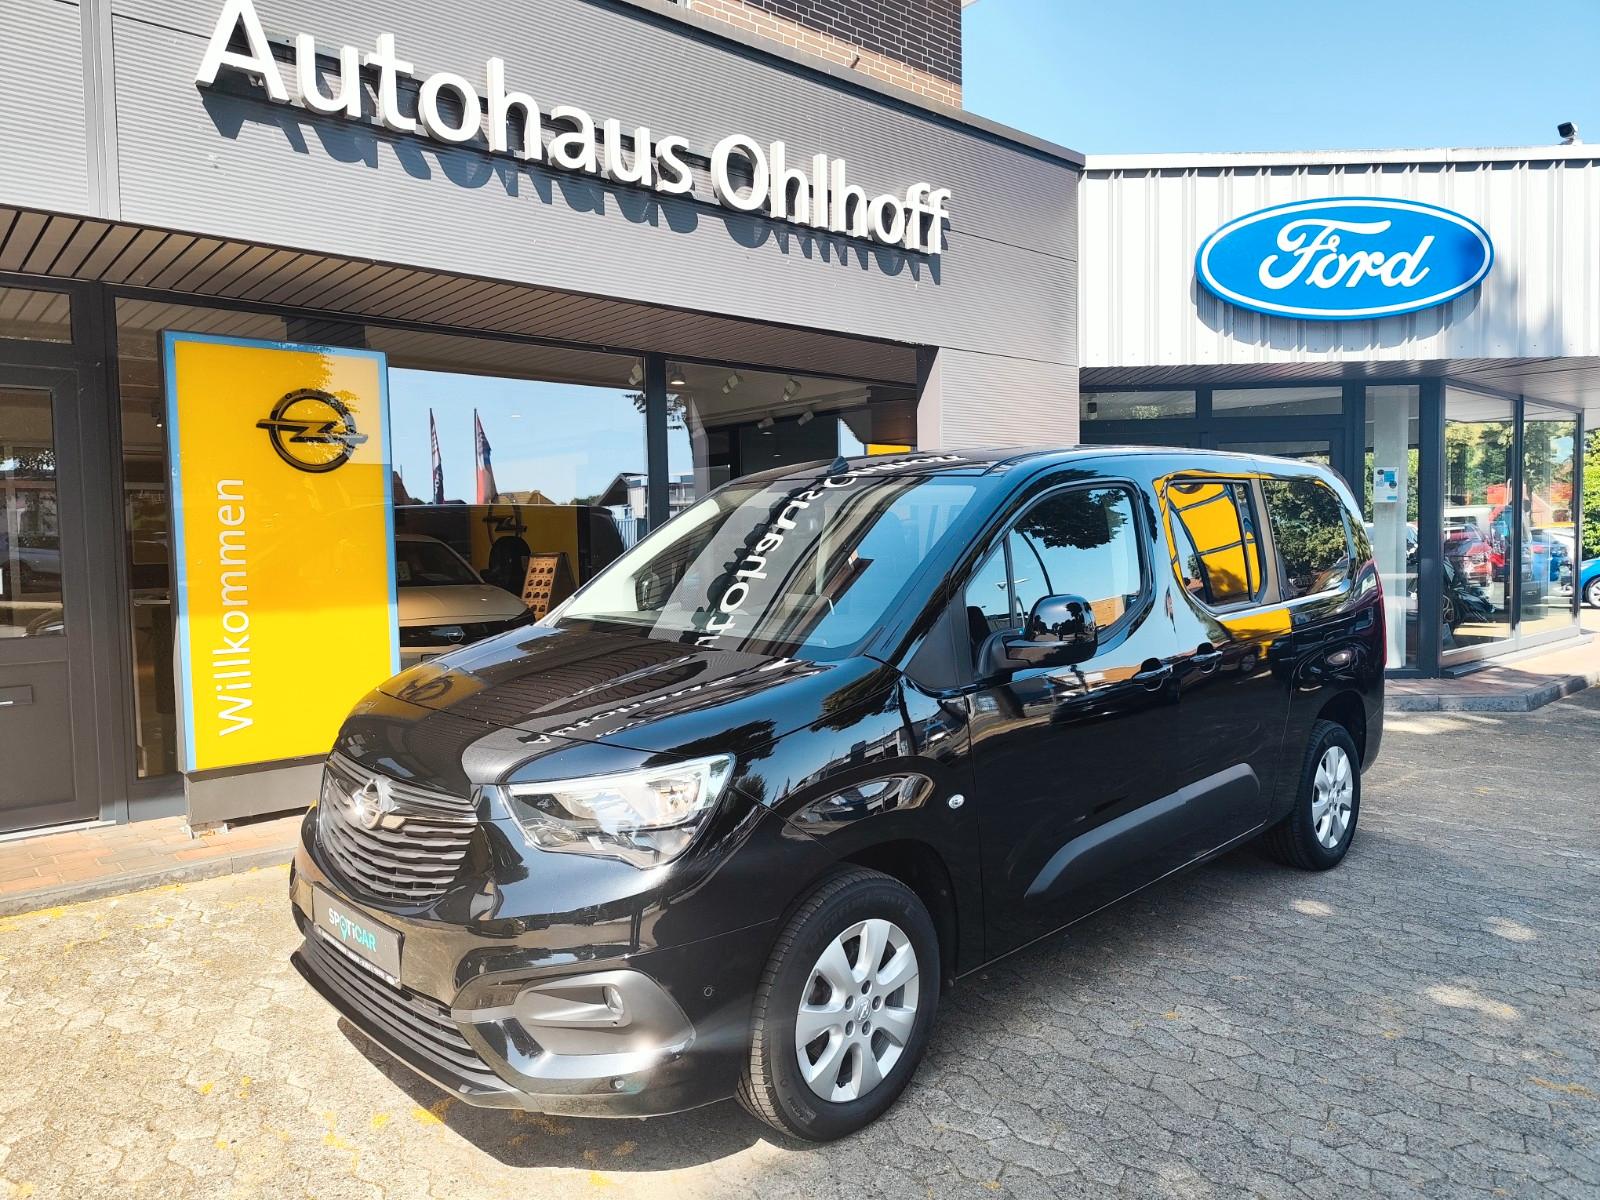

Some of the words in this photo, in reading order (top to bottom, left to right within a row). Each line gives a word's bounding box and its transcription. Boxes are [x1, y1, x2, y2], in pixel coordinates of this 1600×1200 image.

[195, 0, 695, 195] Autohaus
[710, 134, 952, 255] Ohlhoff
[1259, 218, 1435, 290] Ford
[212, 478, 254, 736] Willkommen
